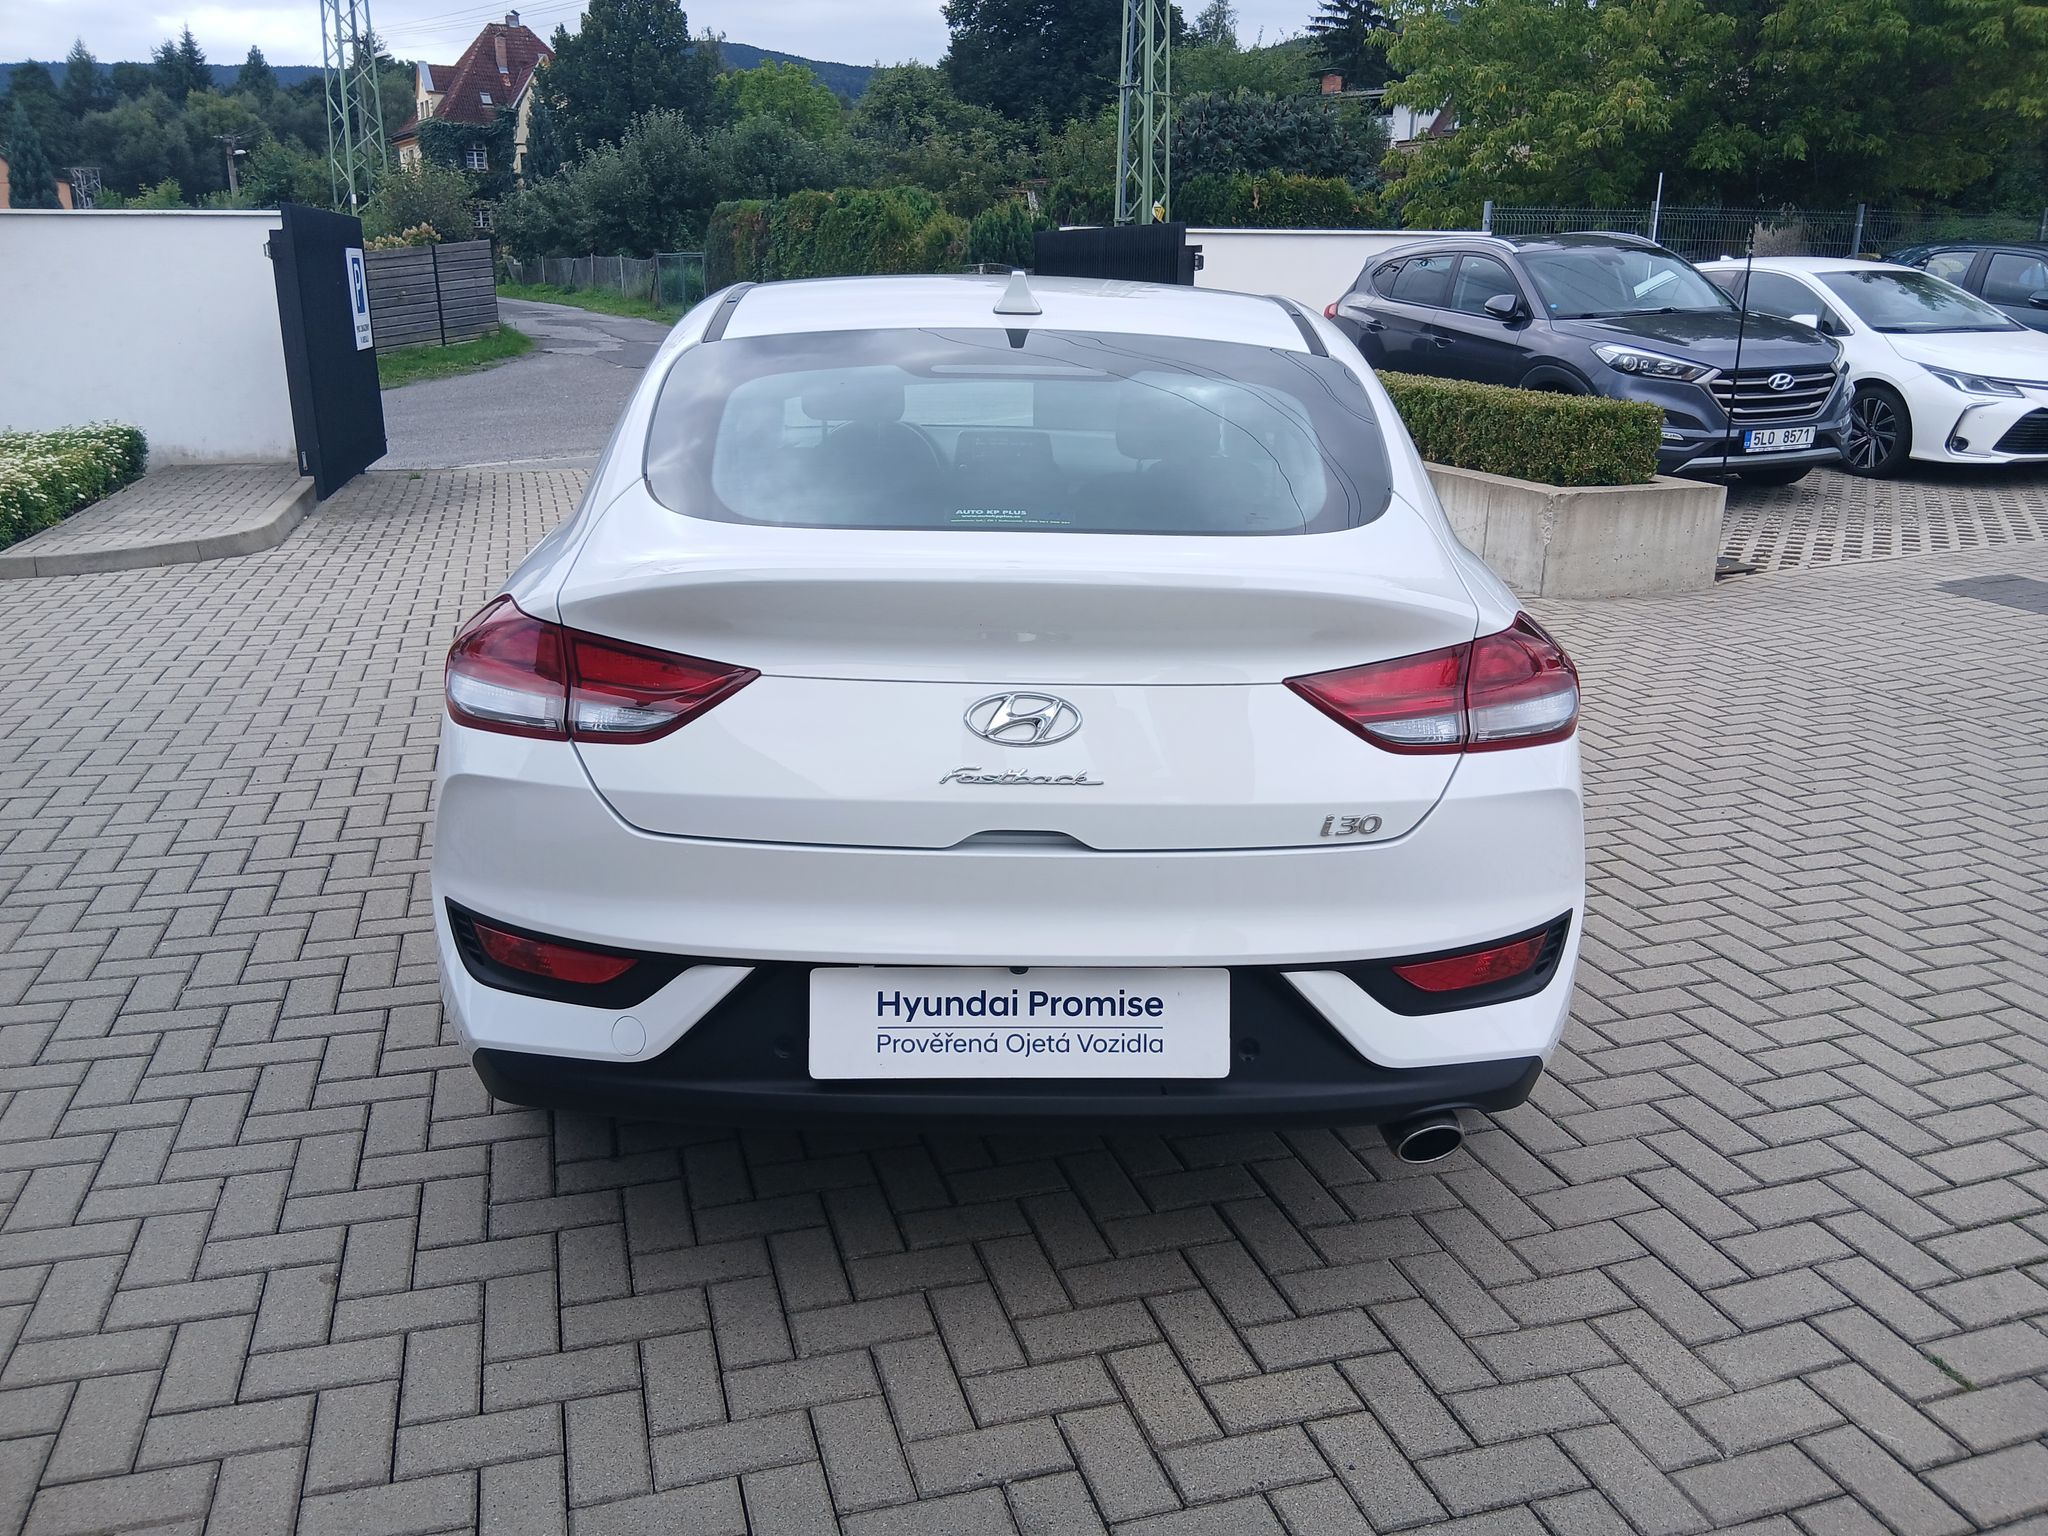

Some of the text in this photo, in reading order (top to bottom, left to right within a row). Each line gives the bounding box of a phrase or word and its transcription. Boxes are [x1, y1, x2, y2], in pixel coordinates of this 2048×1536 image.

[1783, 429, 1809, 444] 8571
[939, 767, 1104, 785] Fastback
[1320, 814, 1382, 836] i30
[877, 989, 1164, 1022] Hyundai Promise
[877, 1032, 1164, 1058] Prověřená Ojetá Vozidla
